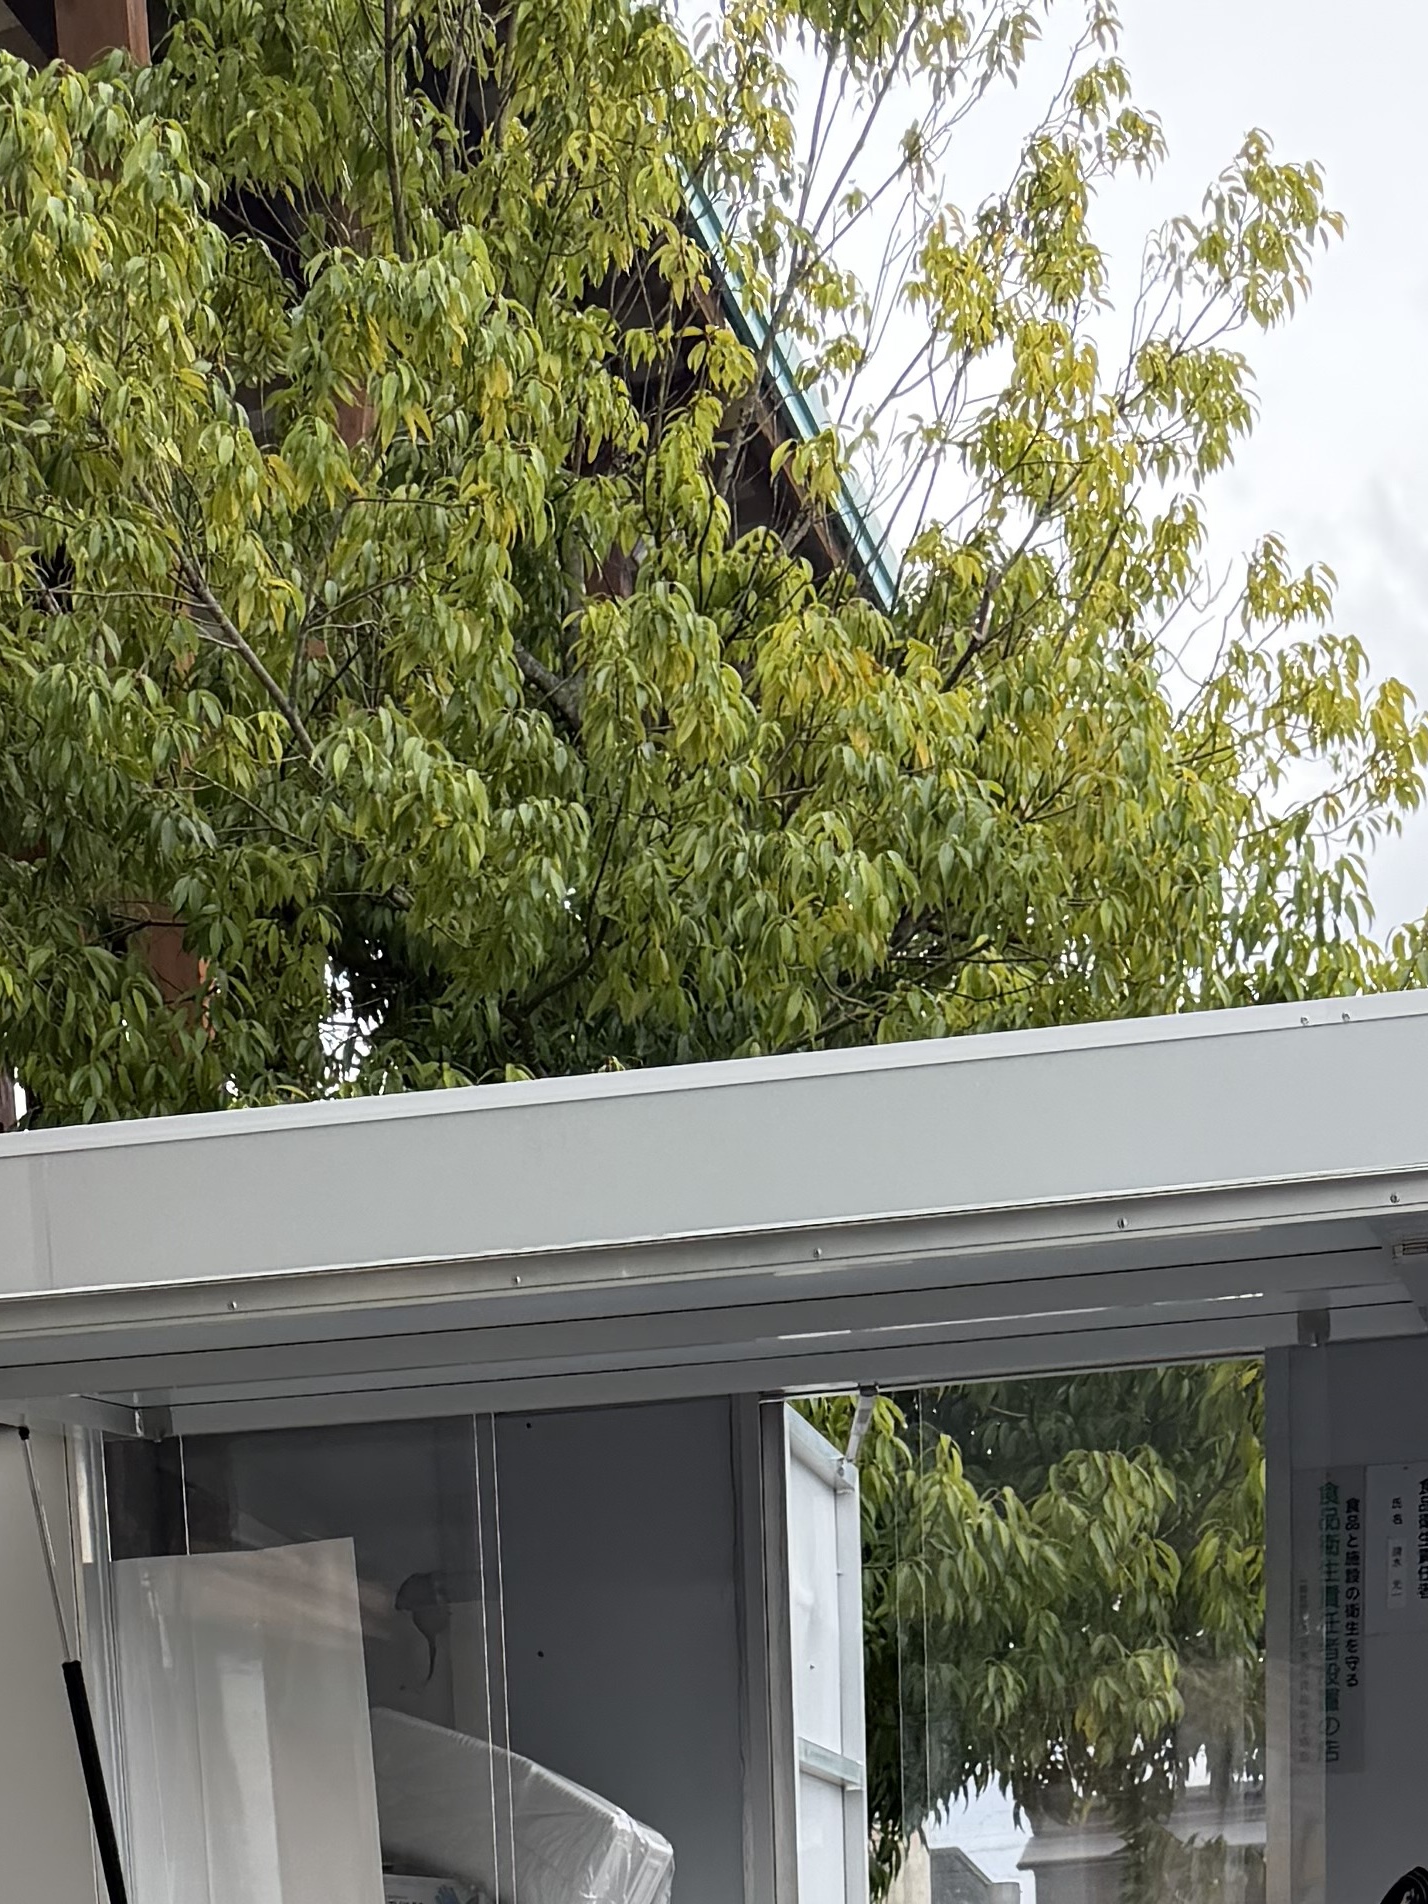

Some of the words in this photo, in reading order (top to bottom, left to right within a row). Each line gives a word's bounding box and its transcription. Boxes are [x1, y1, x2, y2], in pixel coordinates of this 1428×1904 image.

[1345, 1497, 1360, 1688] 食品と施設の衛生を守る
